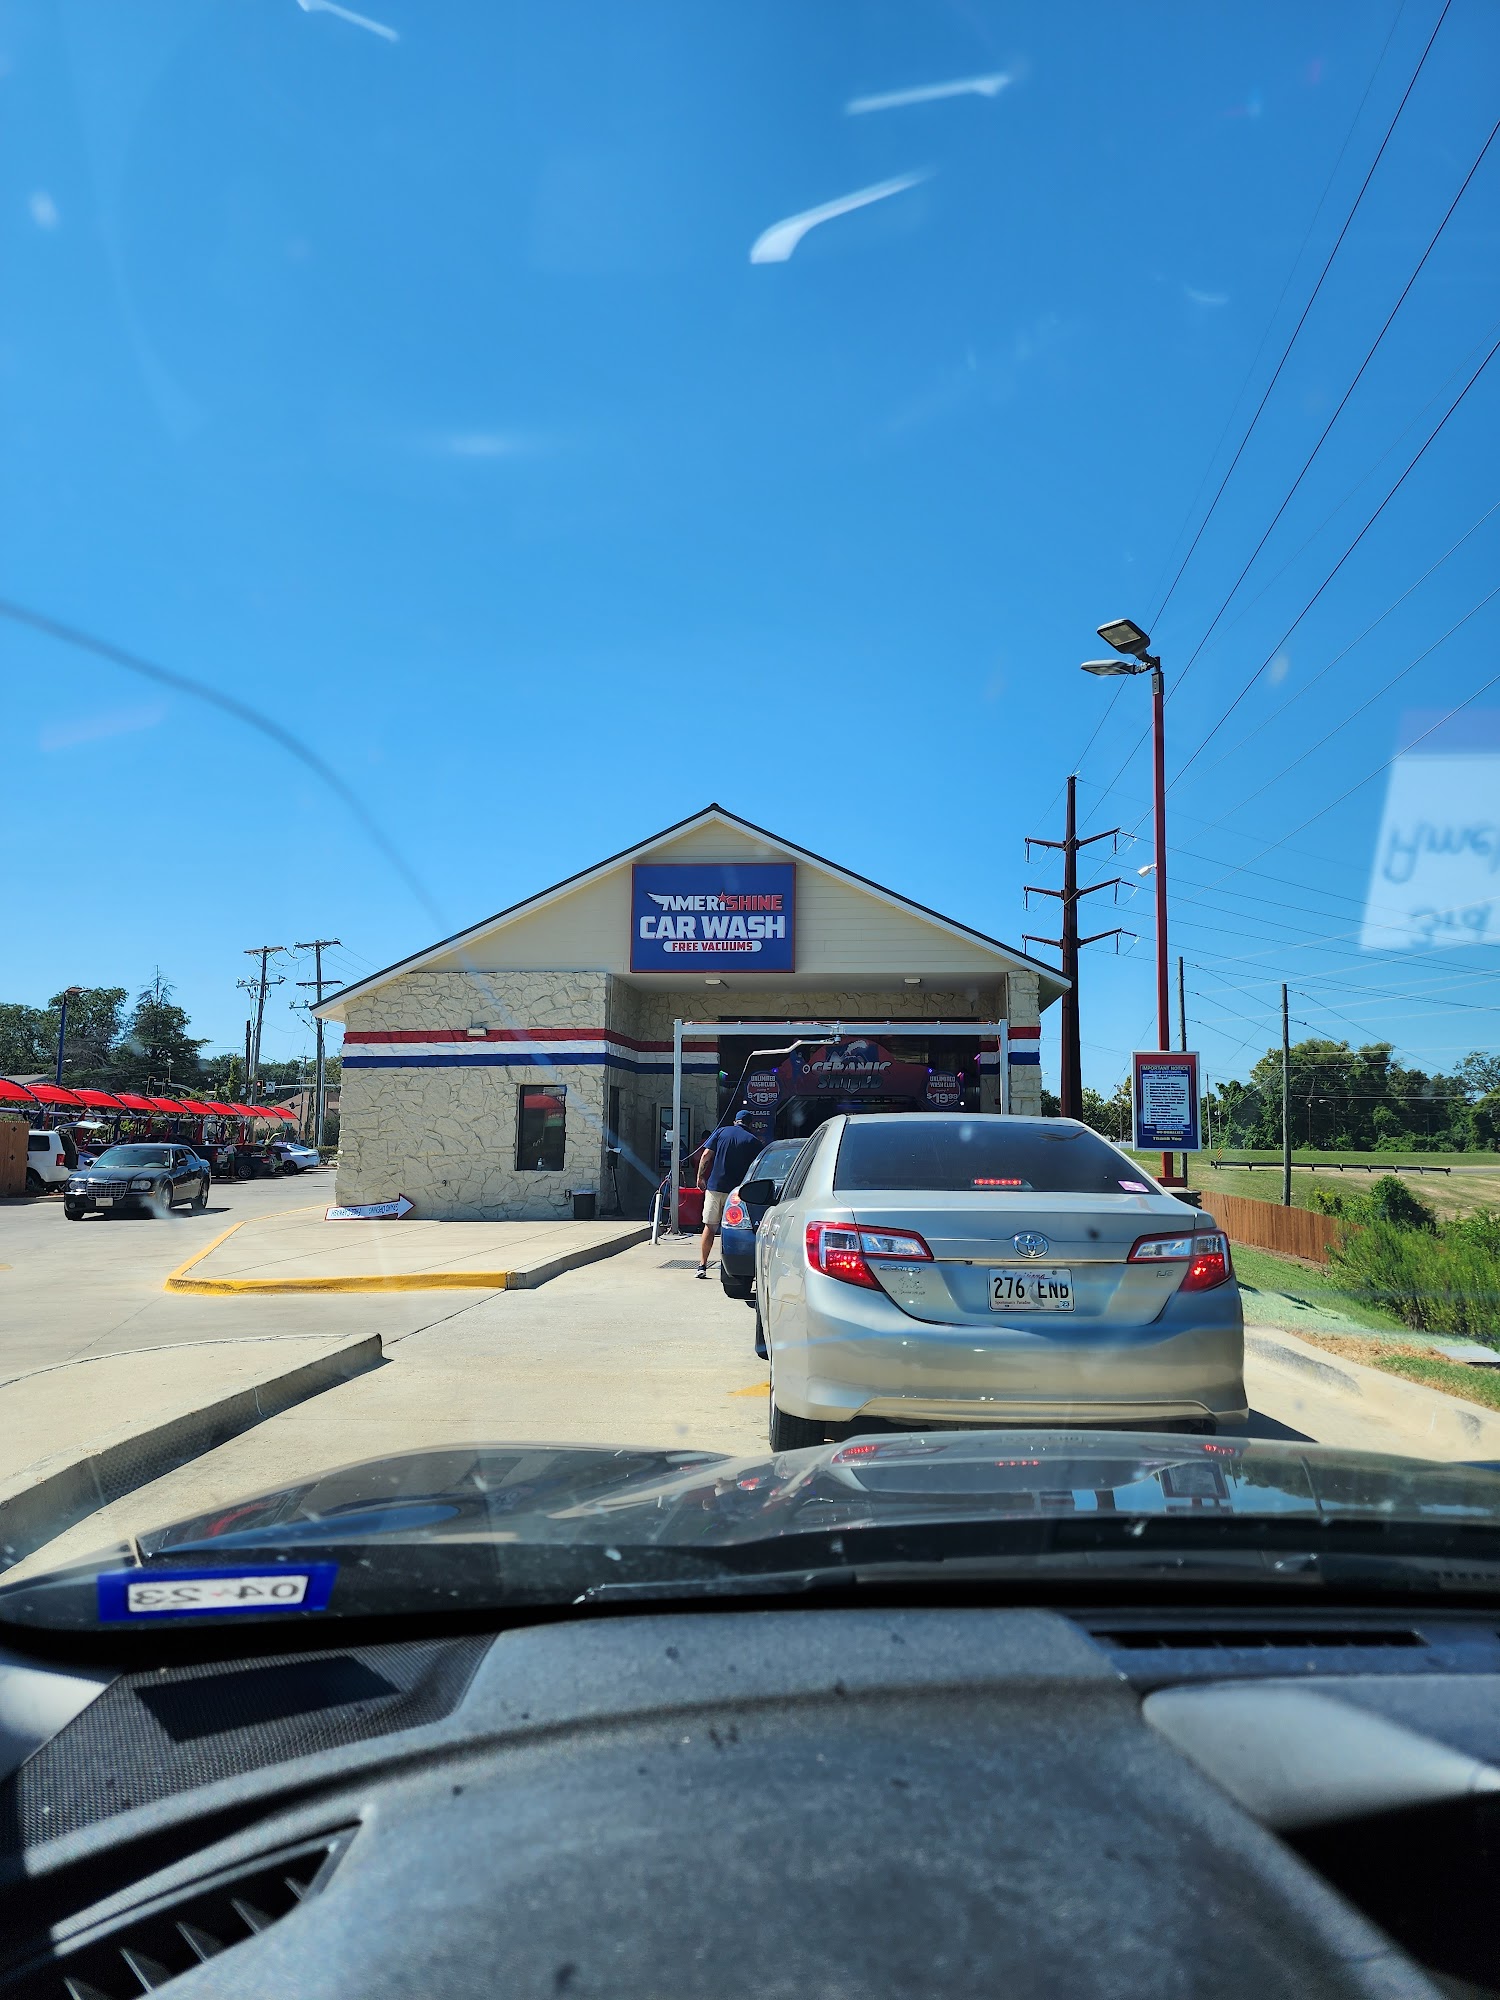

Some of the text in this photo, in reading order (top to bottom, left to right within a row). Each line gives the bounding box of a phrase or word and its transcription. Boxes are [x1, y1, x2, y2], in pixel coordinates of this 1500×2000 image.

[640, 915, 785, 939] CAR WASH
[672, 941, 753, 951] FREE VACUUMS
[812, 1061, 892, 1075] CERAMIC
[818, 1074, 883, 1089] SHIELD
[994, 1276, 1025, 1298] 276
